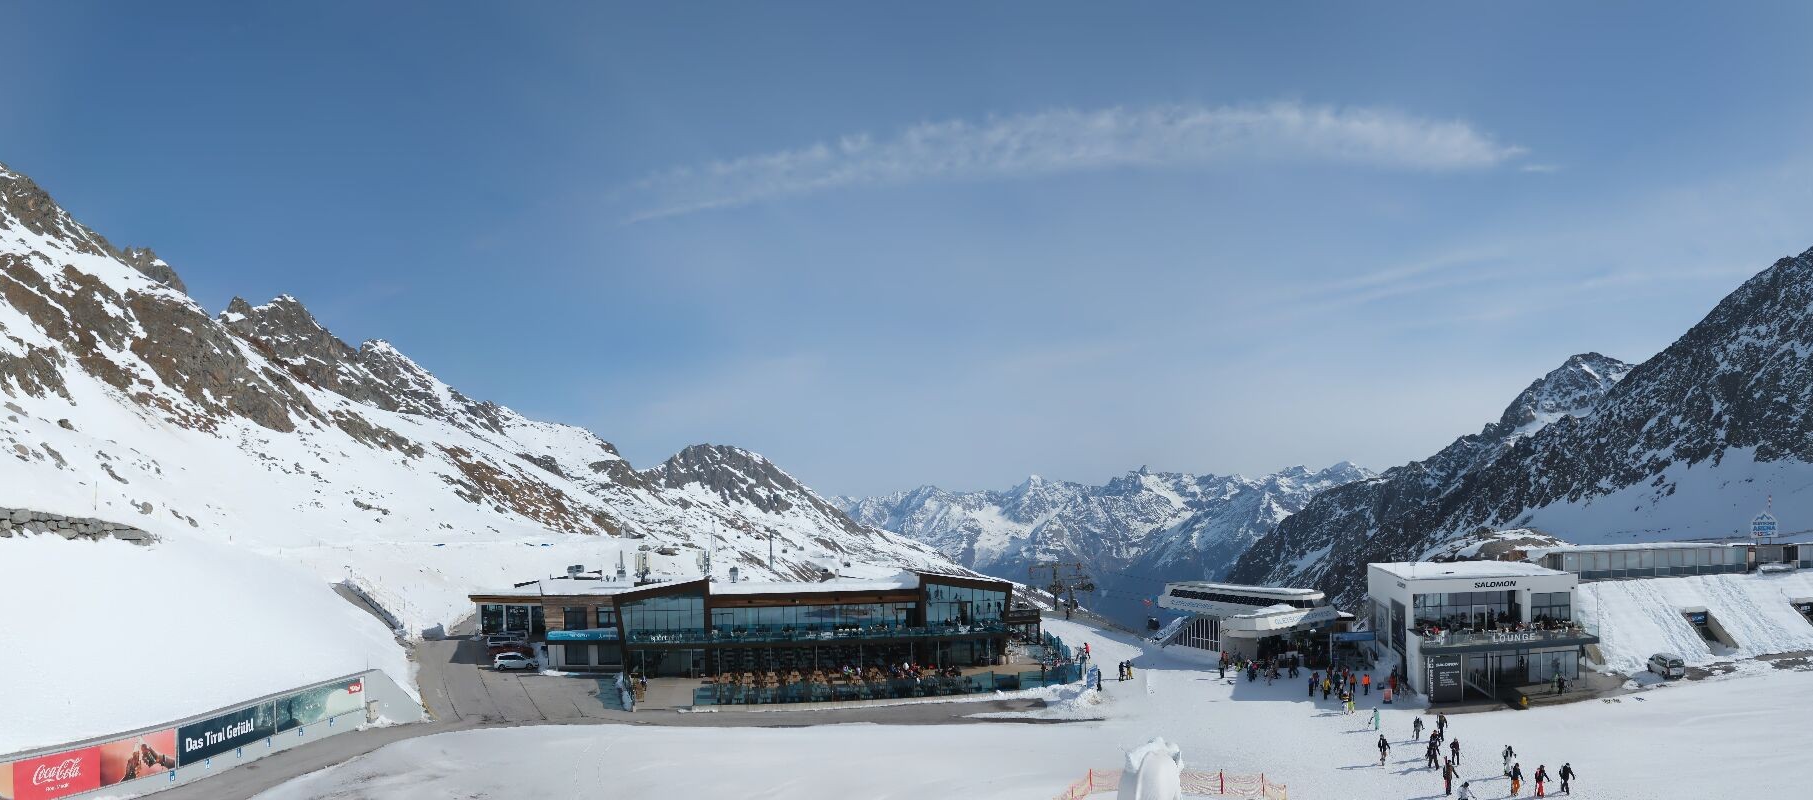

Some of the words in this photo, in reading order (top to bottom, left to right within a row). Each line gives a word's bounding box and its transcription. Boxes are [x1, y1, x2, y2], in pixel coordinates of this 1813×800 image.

[1474, 580, 1517, 589] SALOMON
[1493, 633, 1536, 643] LOUNGE
[185, 737, 204, 753] Das
[205, 727, 225, 747] Tirol
[226, 718, 255, 740] Gefühl
